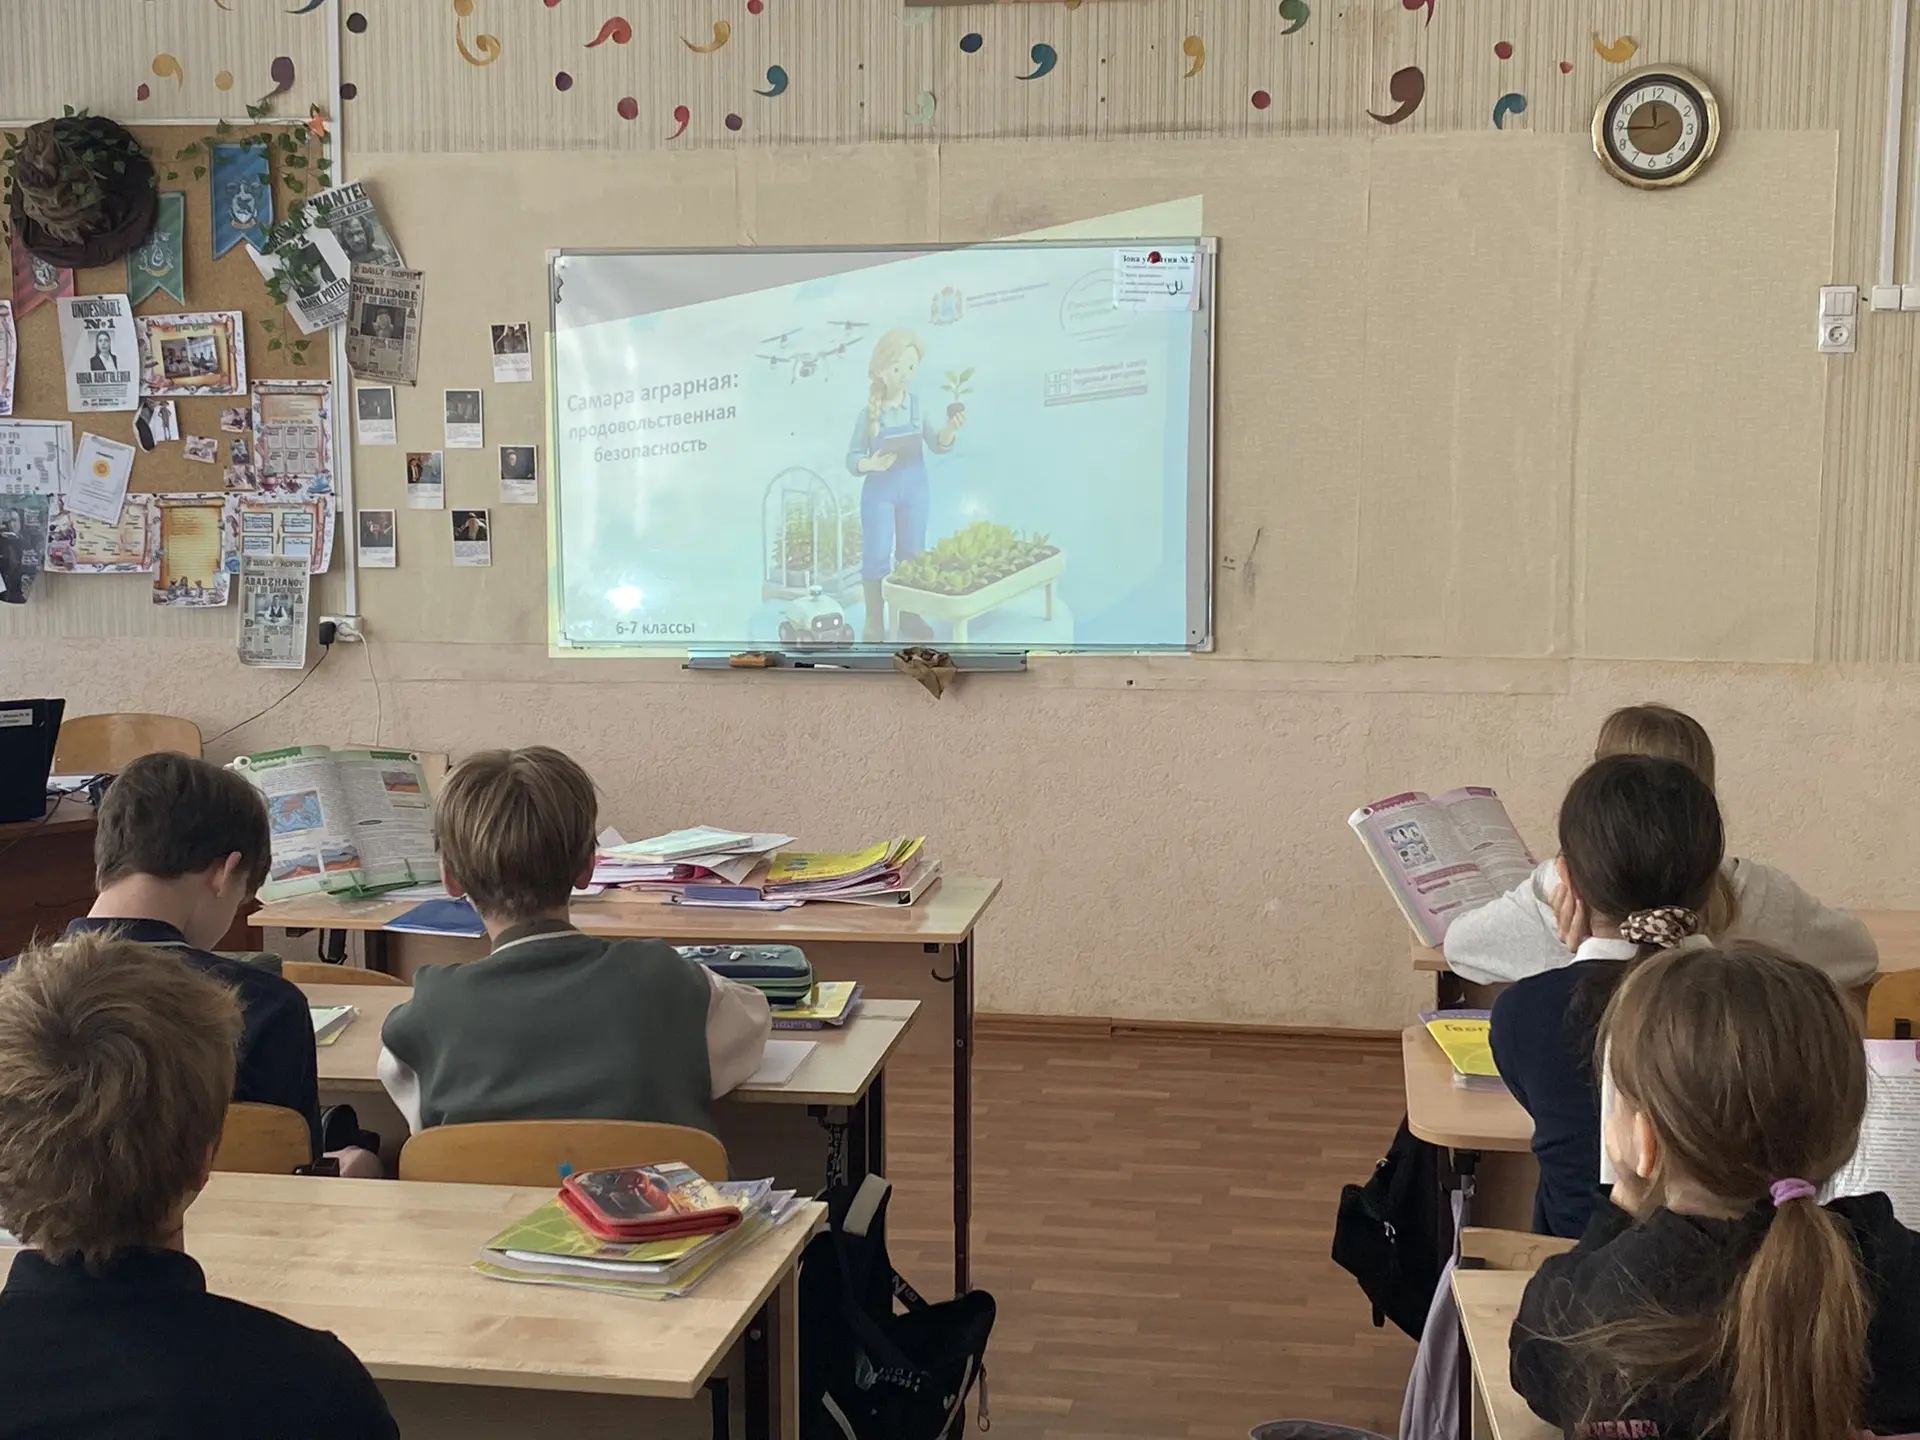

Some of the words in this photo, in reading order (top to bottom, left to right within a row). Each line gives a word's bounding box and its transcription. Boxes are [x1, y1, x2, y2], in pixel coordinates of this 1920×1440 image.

[1636, 91, 1645, 103] 11
[1652, 87, 1665, 99] 12
[1621, 103, 1633, 115] 10
[1683, 105, 1692, 118] 2
[1615, 120, 1625, 132] 9
[1685, 123, 1694, 136] 3
[1619, 138, 1627, 151] 8
[1678, 141, 1686, 153] 4
[1631, 151, 1640, 163] 7
[1647, 156, 1656, 168] 6
[1665, 153, 1674, 165] 5
[295, 294, 323, 311] HARRY
[321, 277, 351, 302] POTTER
[71, 301, 123, 319] UNDESIRABLE
[566, 390, 635, 413] Самара
[640, 372, 740, 403] аграрная:
[568, 405, 737, 441] продовольственная
[593, 437, 708, 463] безопасность
[615, 619, 639, 635] 6-7
[641, 620, 696, 636] классы
